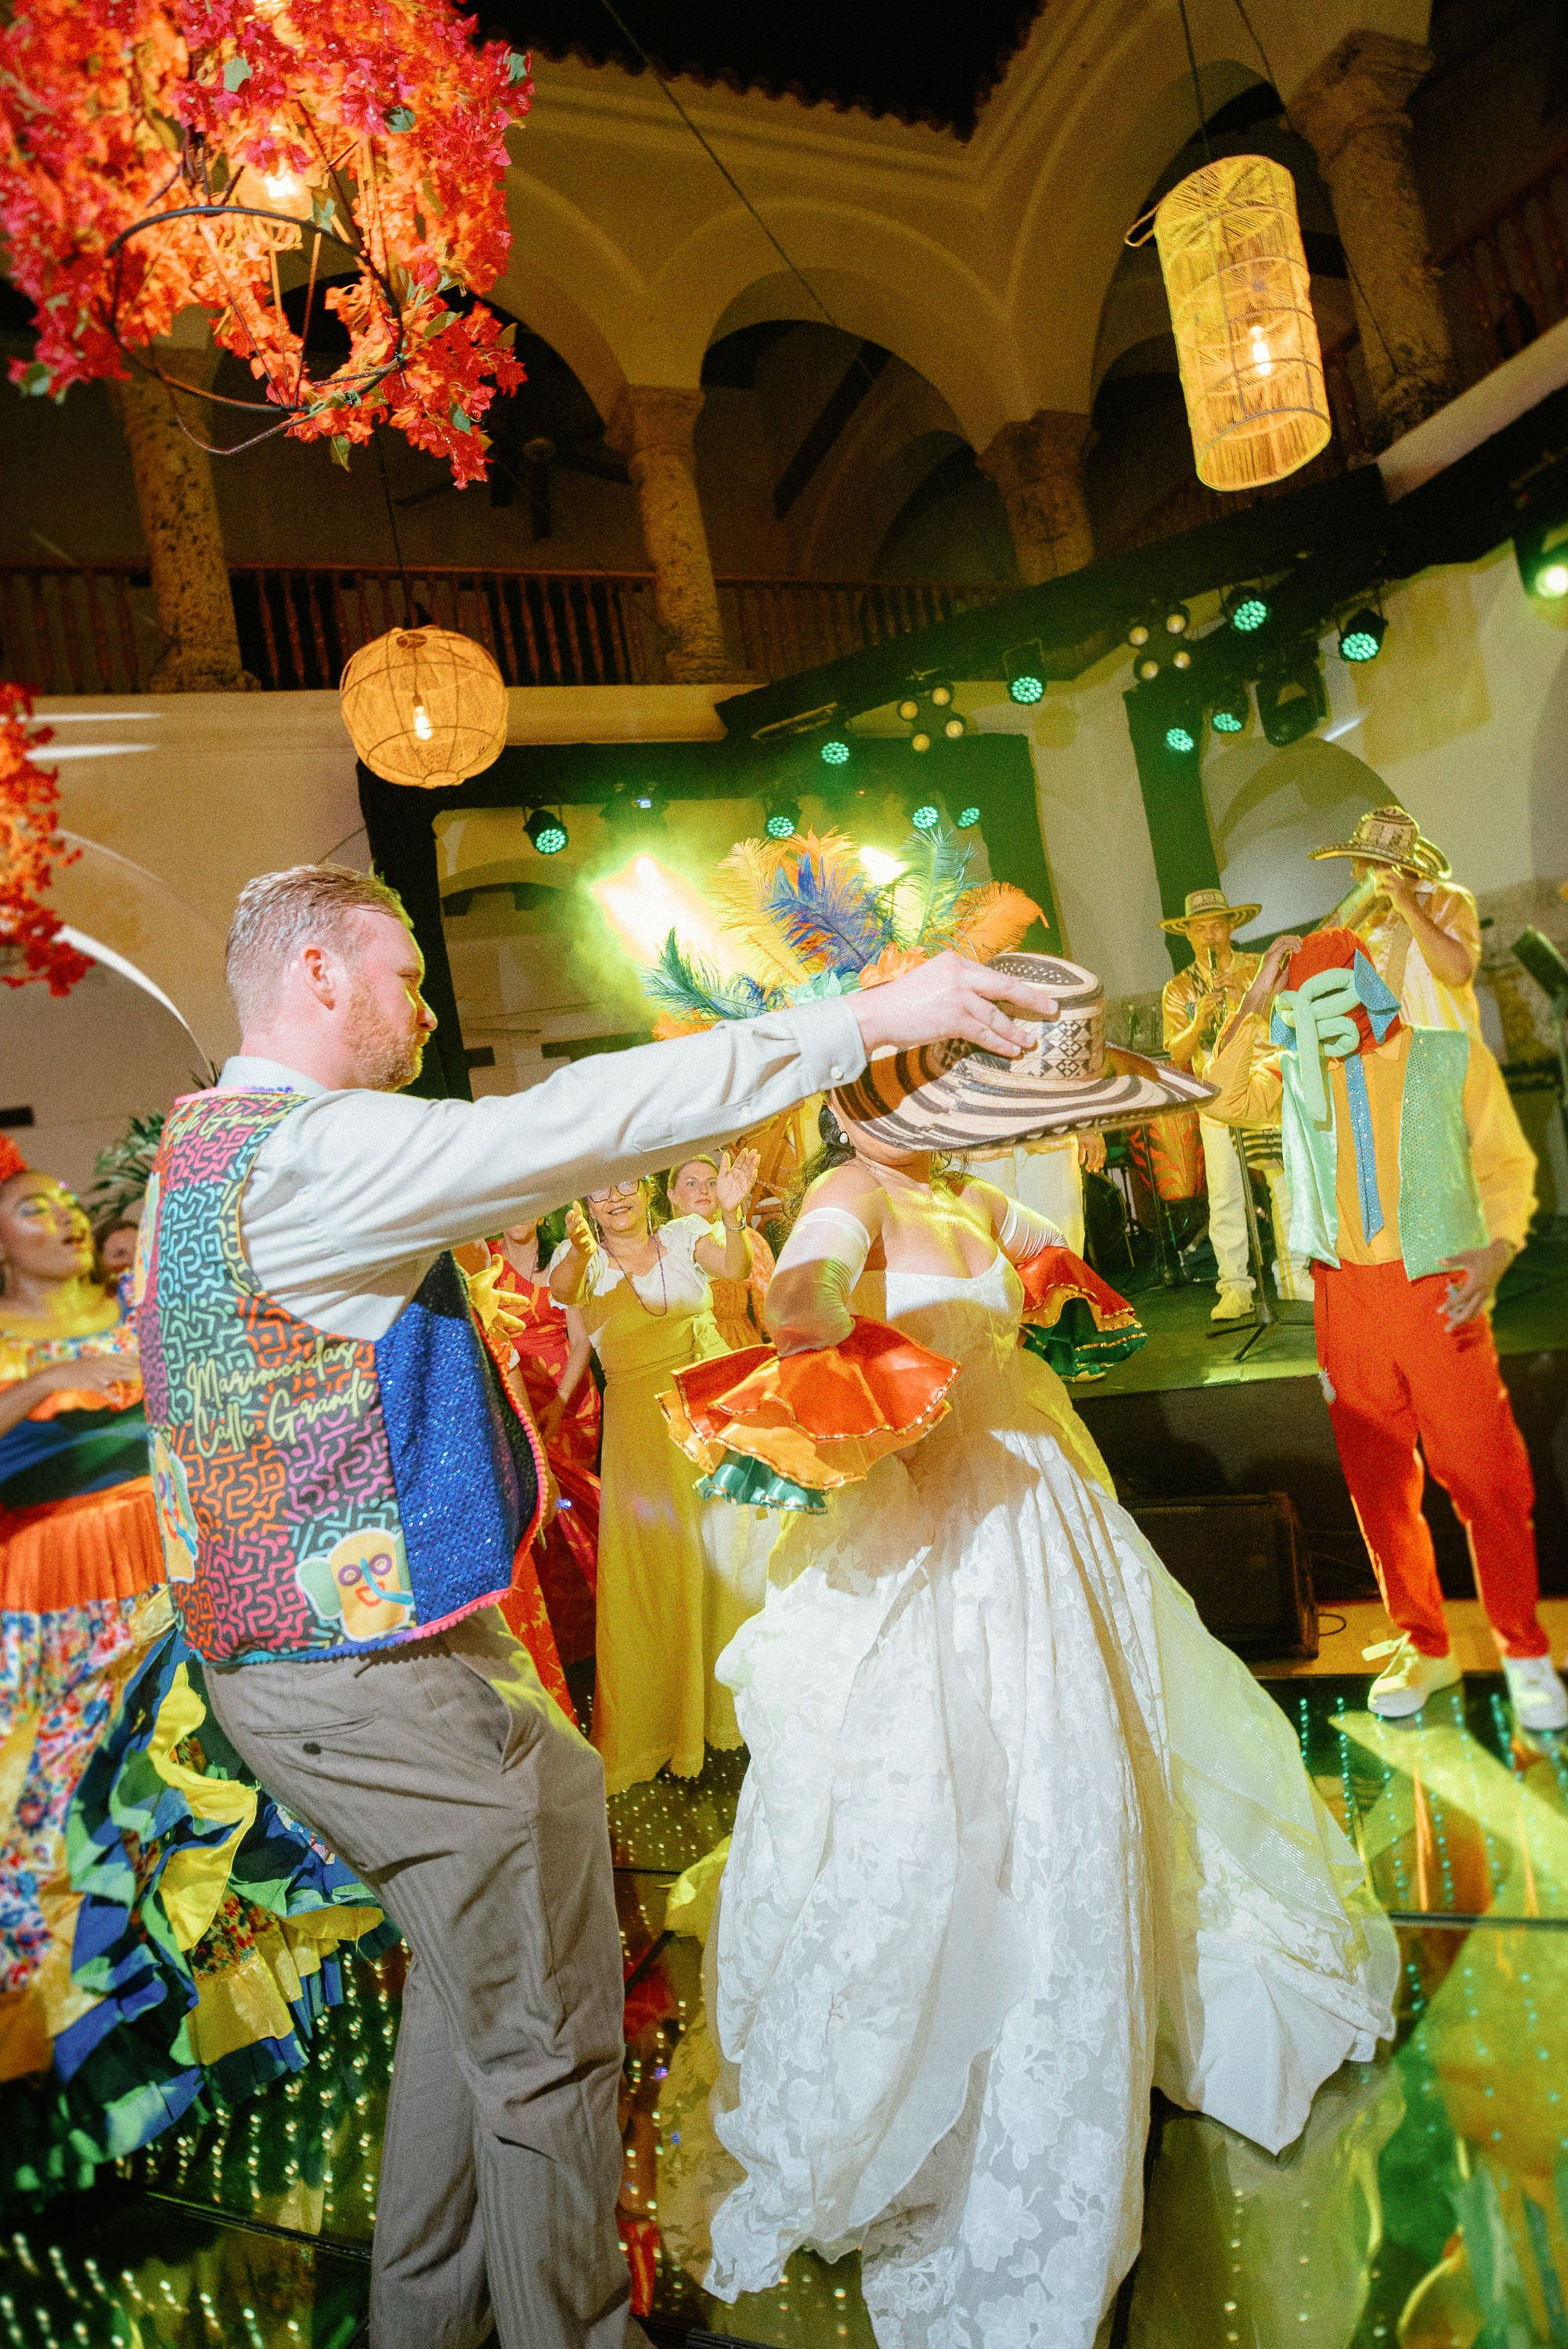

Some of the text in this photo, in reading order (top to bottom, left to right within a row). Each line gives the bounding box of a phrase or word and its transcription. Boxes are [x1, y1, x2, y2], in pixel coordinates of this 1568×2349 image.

[186, 1336, 359, 1409] Marimondas
[195, 1402, 255, 1458] Calle
[268, 1369, 374, 1445] Grande
